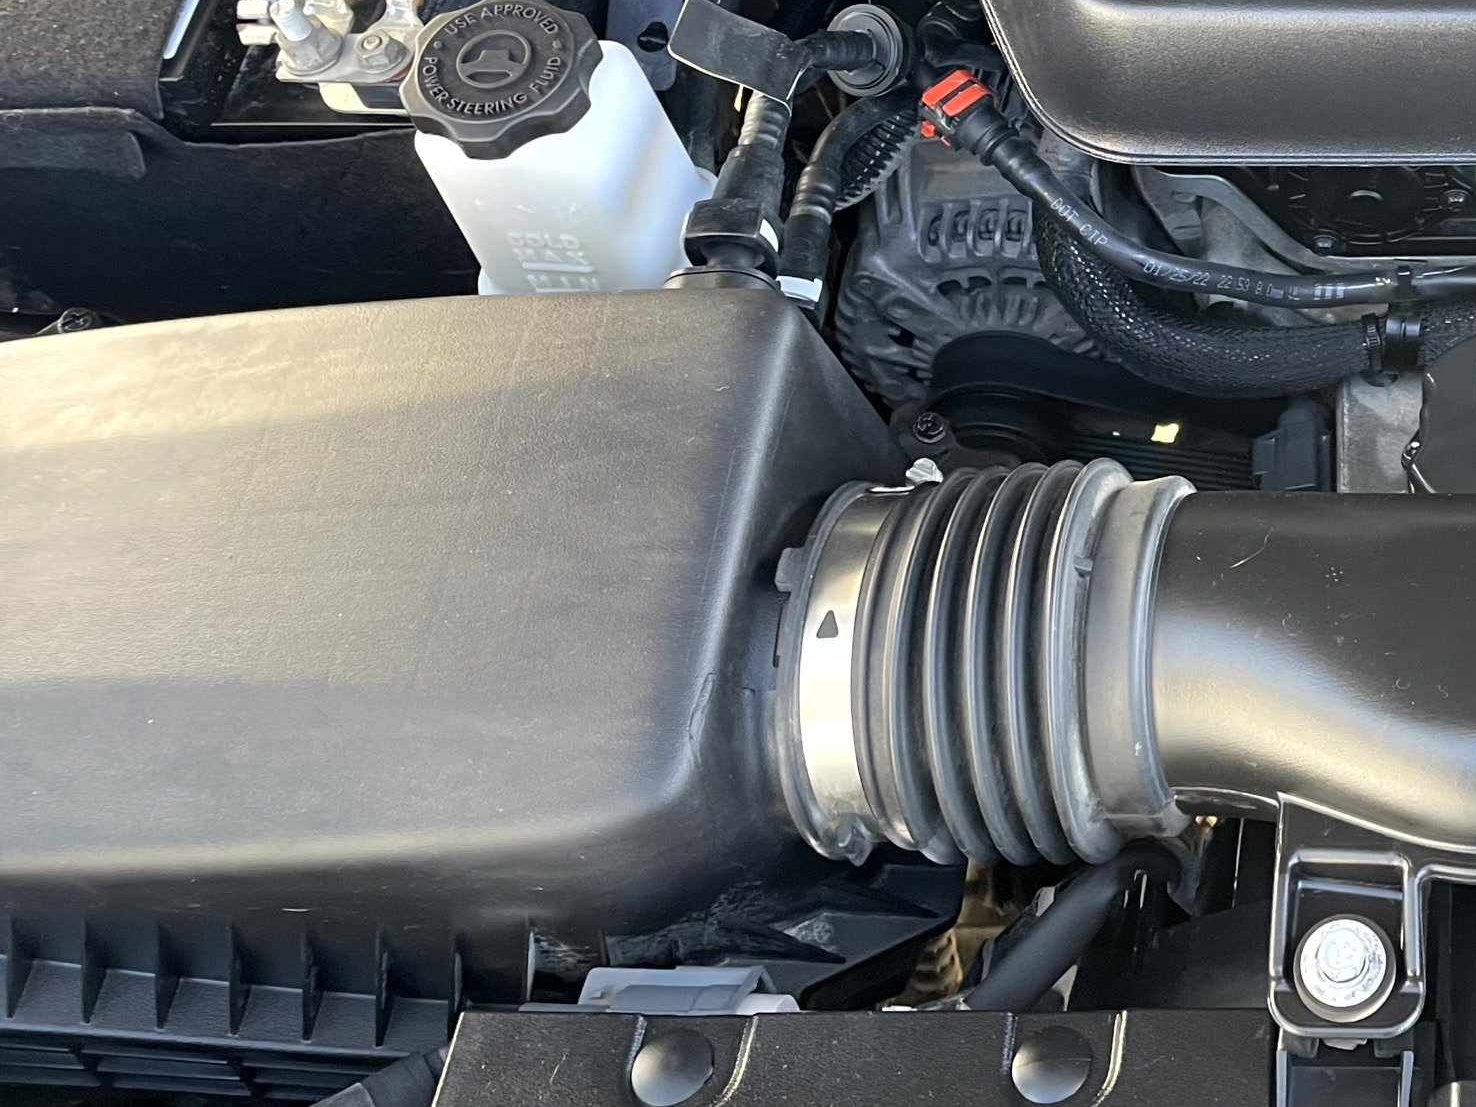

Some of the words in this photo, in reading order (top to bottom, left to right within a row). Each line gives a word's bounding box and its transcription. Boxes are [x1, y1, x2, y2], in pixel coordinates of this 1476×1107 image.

[444, 13, 478, 35] USE
[480, 4, 560, 34] APPROVED
[422, 56, 450, 103] POWER
[446, 93, 527, 115] STEERING
[529, 56, 561, 94] FLUID
[1050, 197, 1079, 222] DOT
[1080, 224, 1108, 245] CIP
